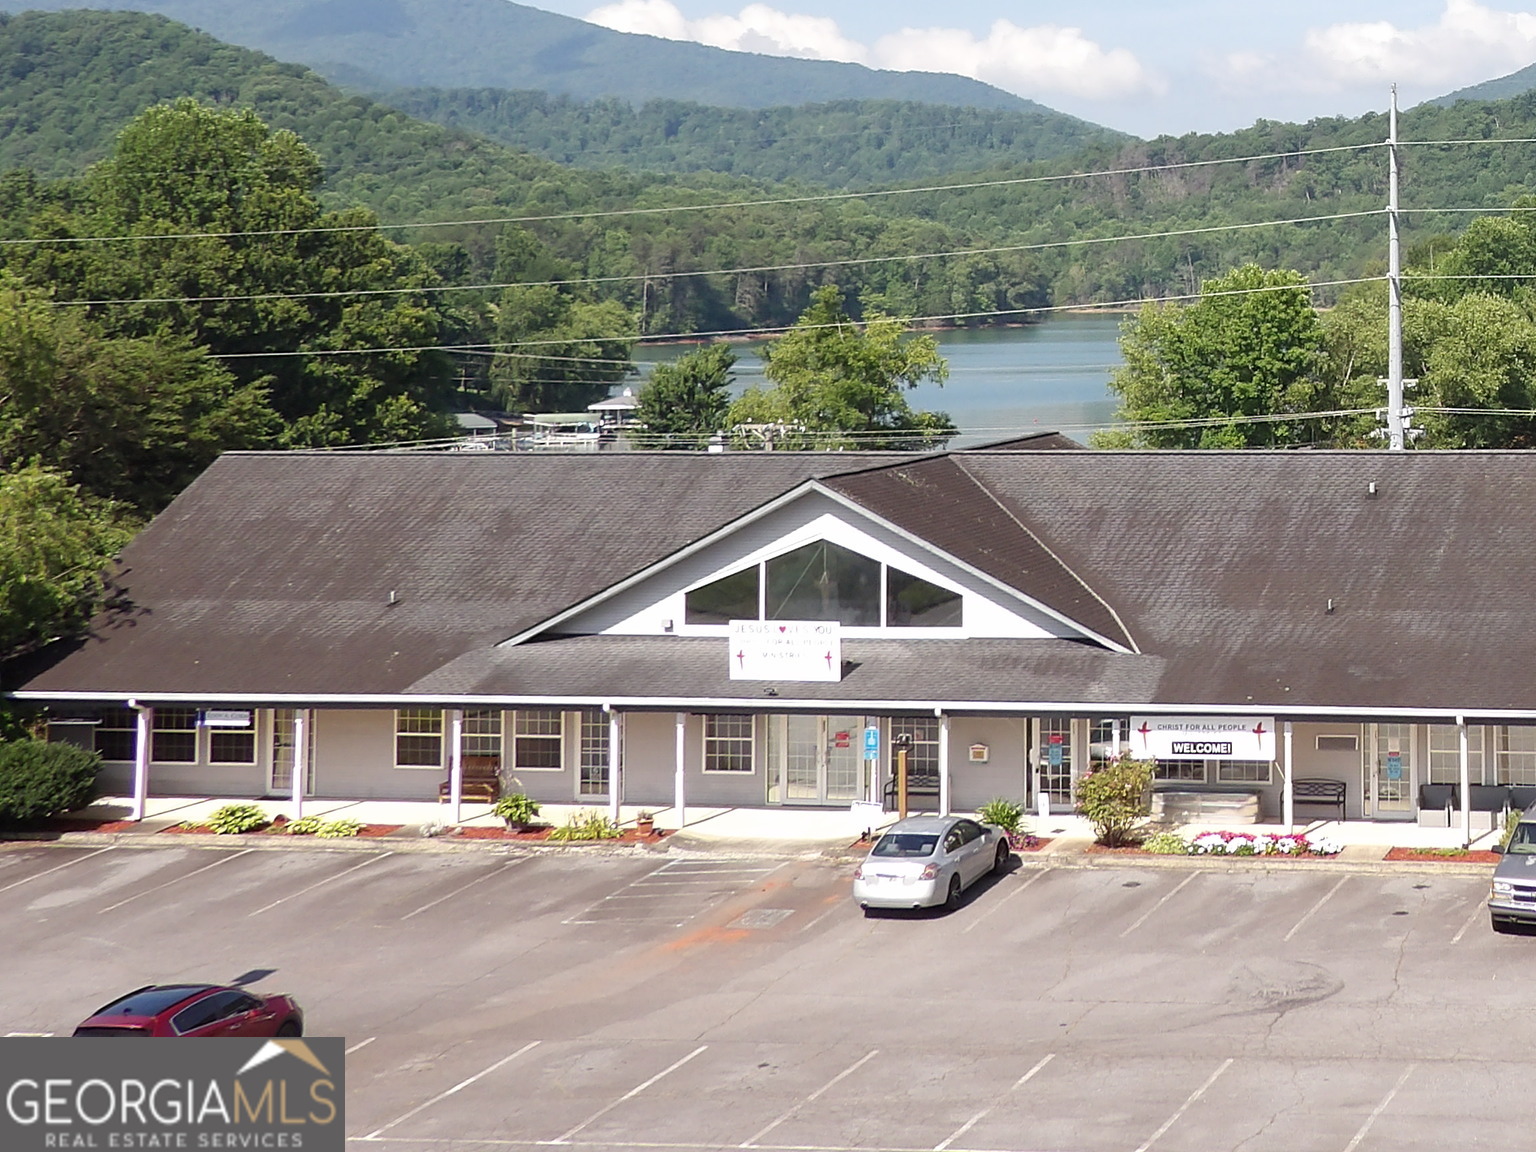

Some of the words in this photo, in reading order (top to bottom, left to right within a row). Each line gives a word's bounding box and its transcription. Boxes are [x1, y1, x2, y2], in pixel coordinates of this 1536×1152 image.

[735, 624, 770, 634] JESUS
[1157, 723, 1183, 731] CHRIST
[1186, 723, 1200, 731] FOR
[1218, 724, 1247, 732] PEOPLE
[1173, 742, 1231, 754] WELCOME!
